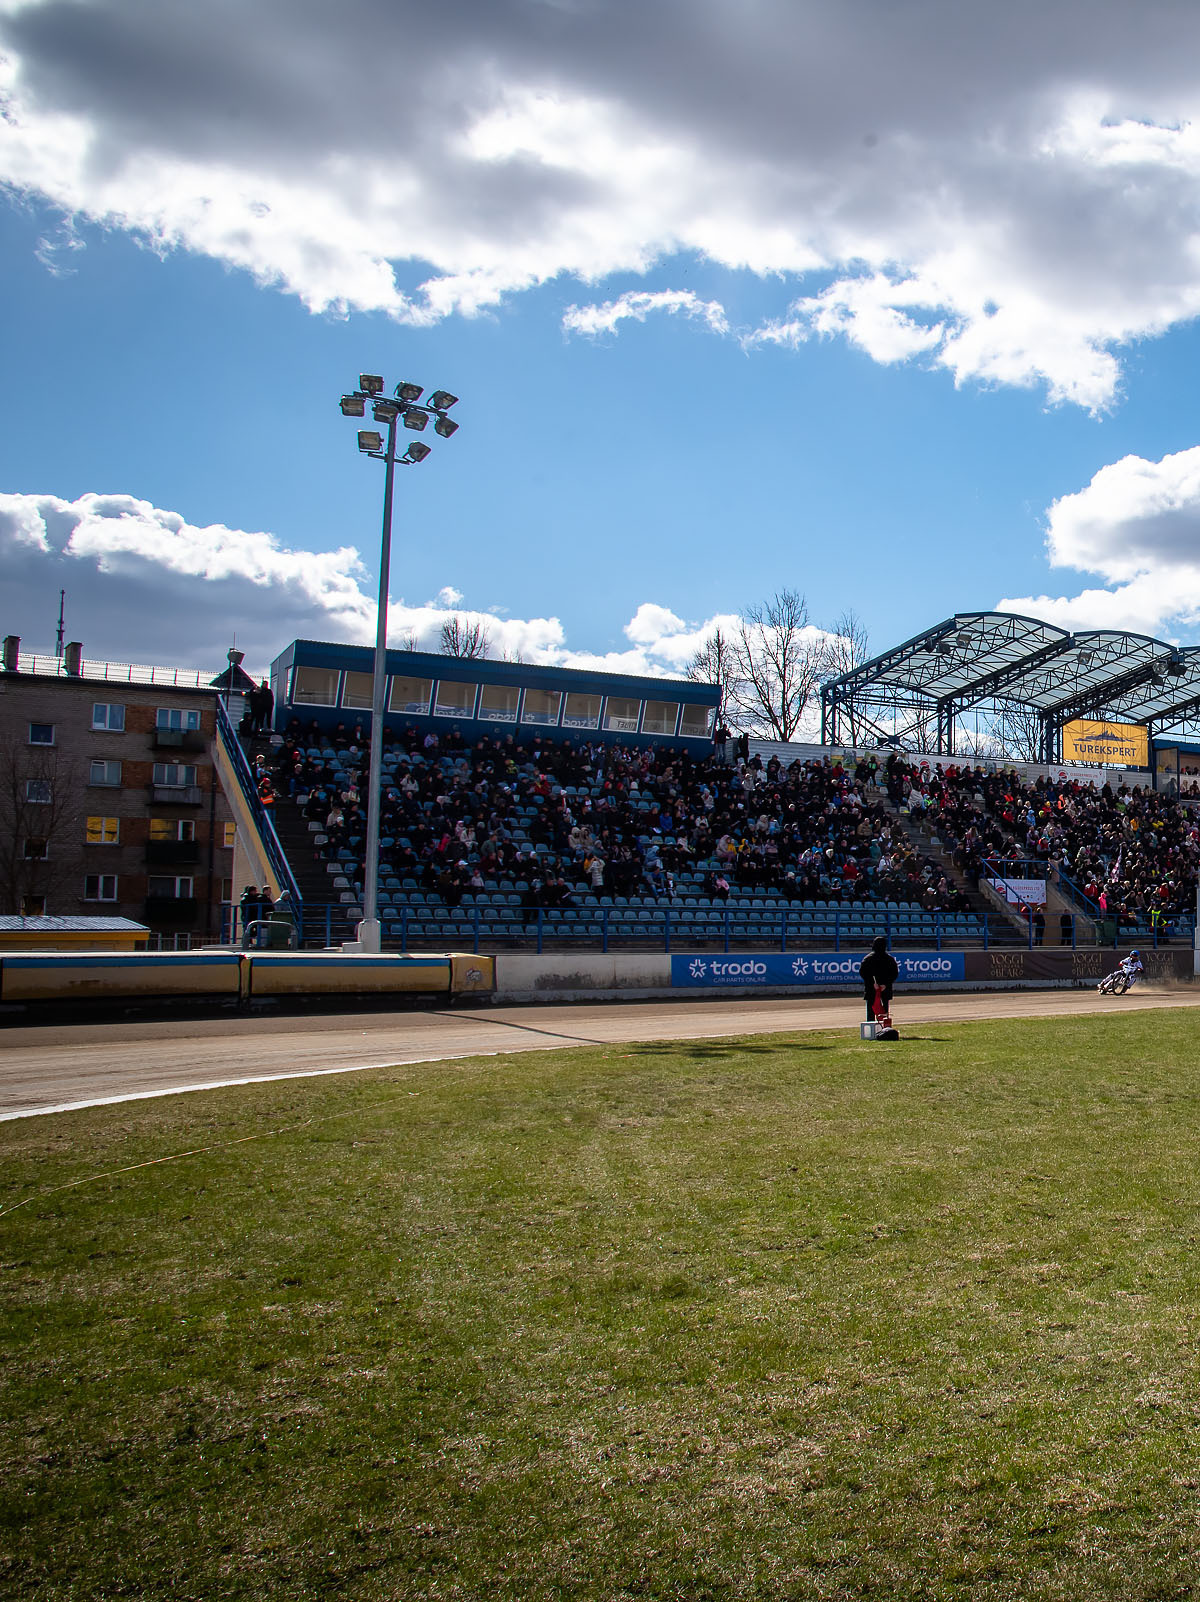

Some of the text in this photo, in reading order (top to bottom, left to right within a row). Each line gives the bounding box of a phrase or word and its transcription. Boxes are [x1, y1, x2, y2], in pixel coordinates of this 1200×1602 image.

[1072, 743, 1137, 757] TUREKSPERT
[904, 957, 952, 972] trodo
[990, 953, 1024, 965] YOGGI
[1072, 952, 1102, 964] YOGGI
[710, 959, 767, 975] trodo
